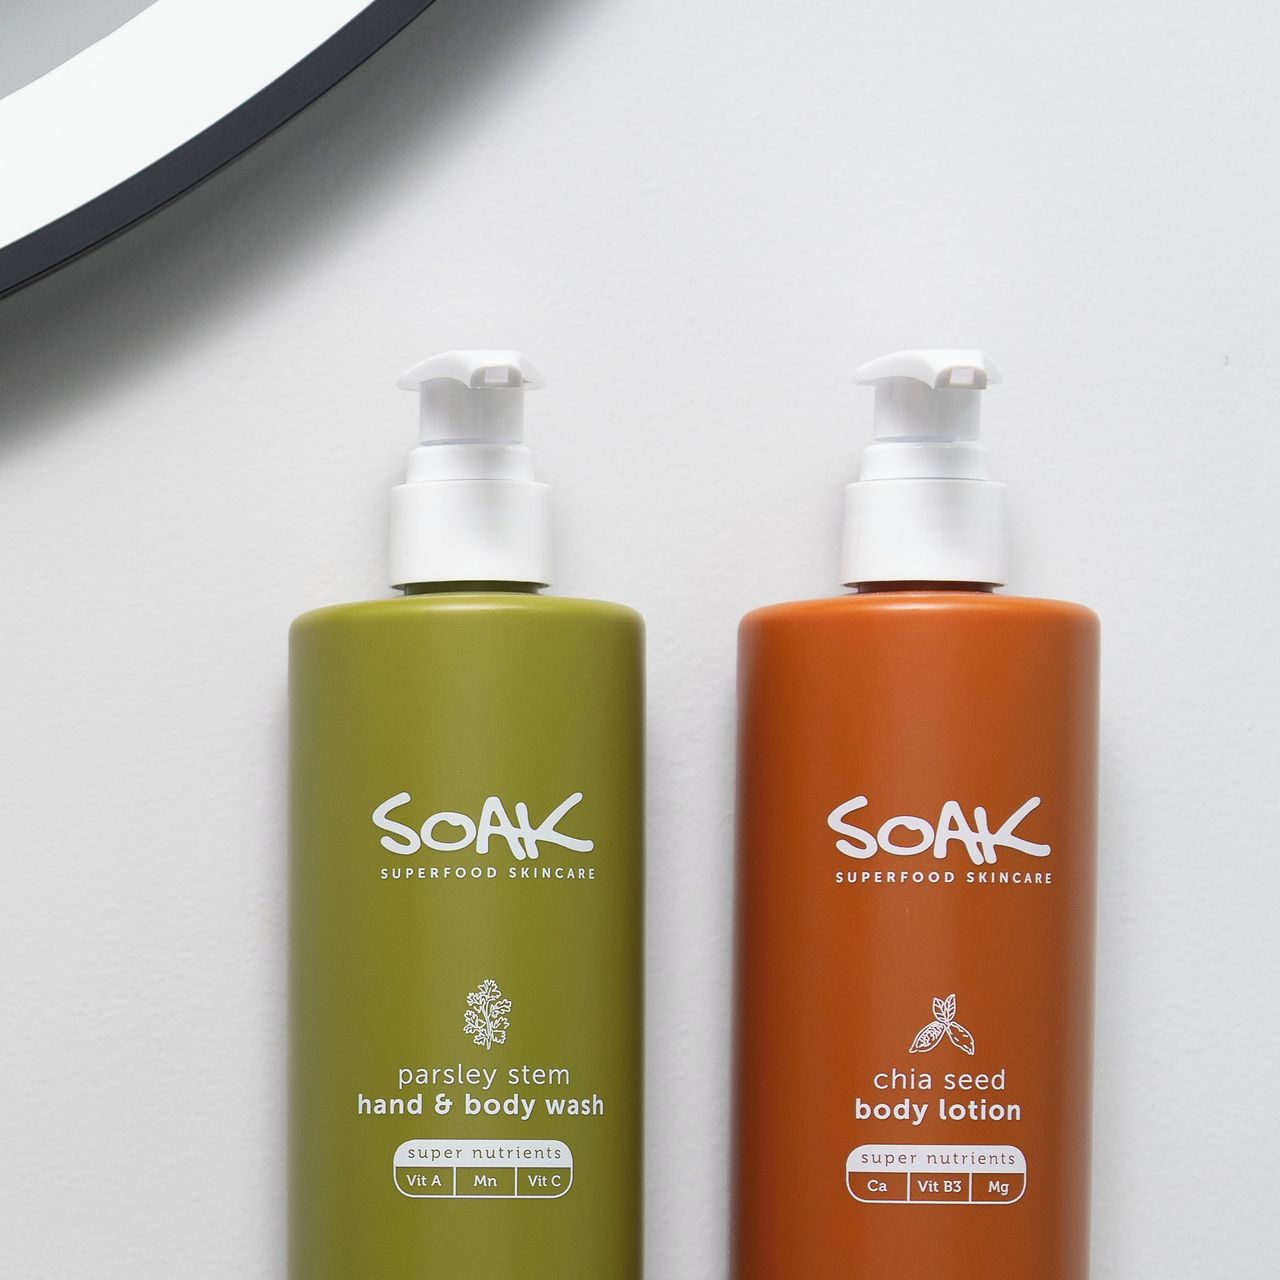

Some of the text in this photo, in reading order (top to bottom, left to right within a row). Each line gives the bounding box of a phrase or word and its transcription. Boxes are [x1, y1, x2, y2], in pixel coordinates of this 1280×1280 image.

[372, 792, 594, 860] SOAK
[827, 796, 1051, 865] SOAK
[380, 866, 595, 880] SUPERFOOD SKINCARE
[835, 871, 1052, 884] SUPERFOOD SKINCARE
[398, 1063, 570, 1090] parsley stem
[873, 1067, 1006, 1090] chia seed
[358, 1093, 604, 1121] hand & body wash
[855, 1098, 1021, 1126] body lotion
[408, 1147, 561, 1161] super nutrients
[861, 1151, 1016, 1167] super nutrients
[406, 1174, 442, 1187] Vit A
[473, 1174, 498, 1187] Mn
[527, 1174, 562, 1188] Vit C
[867, 1179, 888, 1192] Ca
[917, 1180, 962, 1193] Vit B3
[987, 1180, 1010, 1196] Mg
